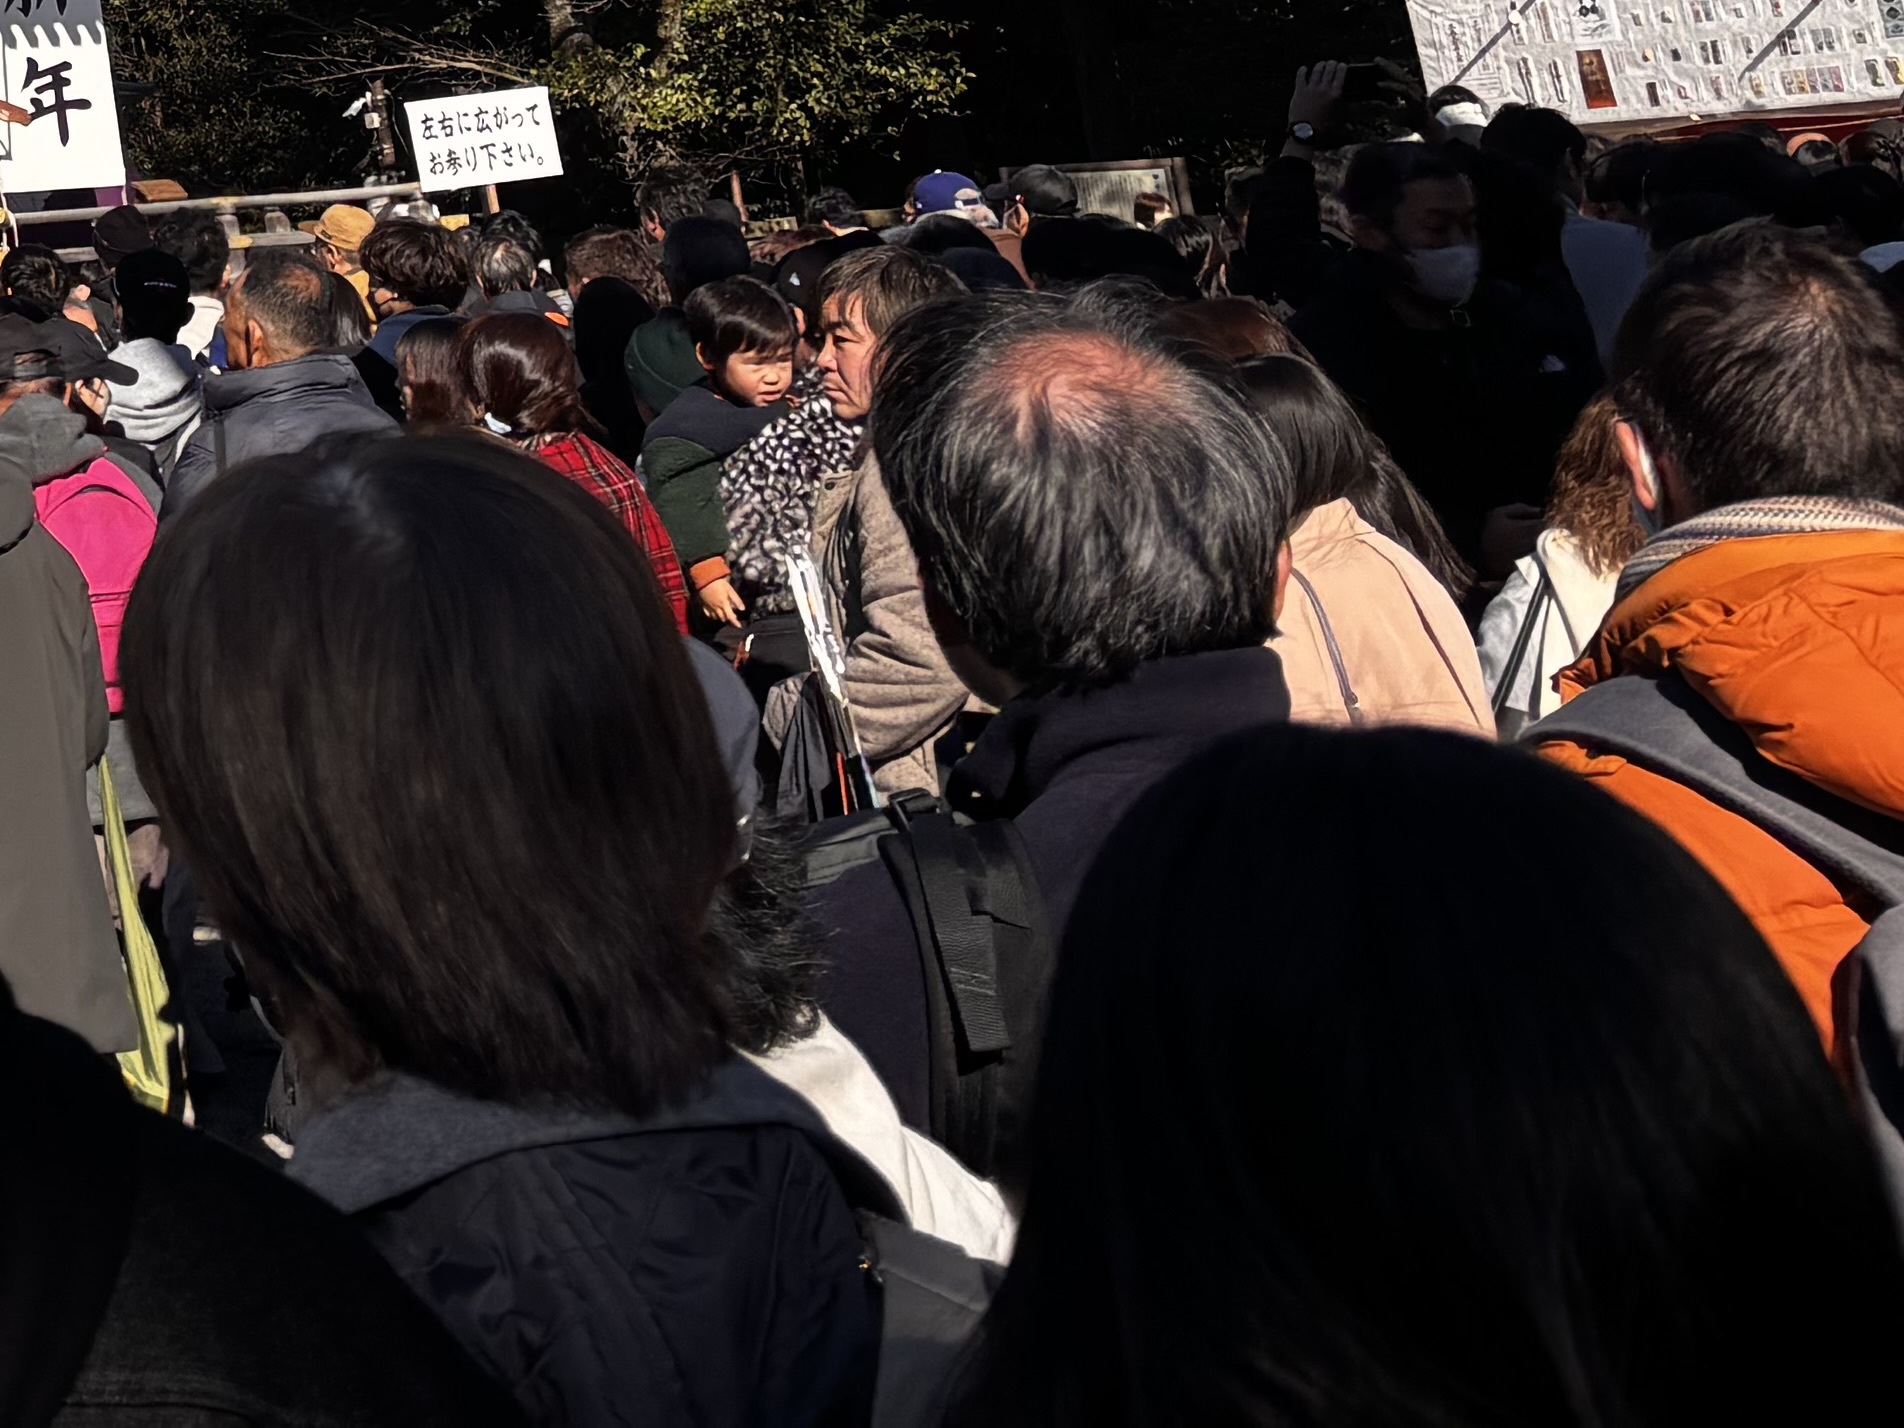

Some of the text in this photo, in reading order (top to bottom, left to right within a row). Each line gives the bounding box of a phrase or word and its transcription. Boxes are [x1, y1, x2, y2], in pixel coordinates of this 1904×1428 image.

[420, 103, 541, 141] 左右に広がって
[429, 141, 544, 177] お参り下さい。
